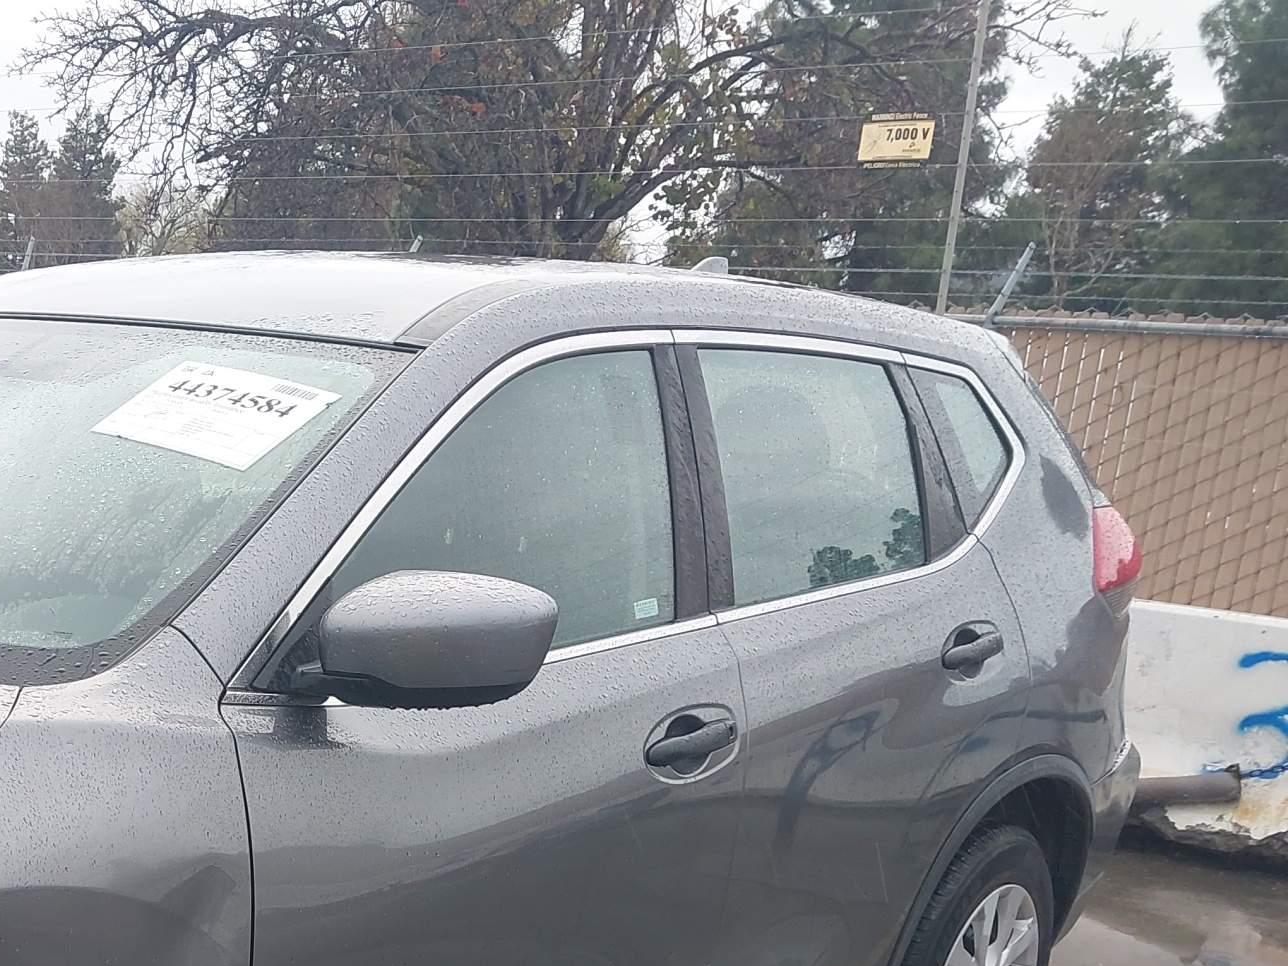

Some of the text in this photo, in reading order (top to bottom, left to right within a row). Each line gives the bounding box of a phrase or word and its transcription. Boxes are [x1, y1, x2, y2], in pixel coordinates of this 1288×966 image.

[886, 127, 930, 142] 7,000 V
[168, 380, 297, 417] 44374584
